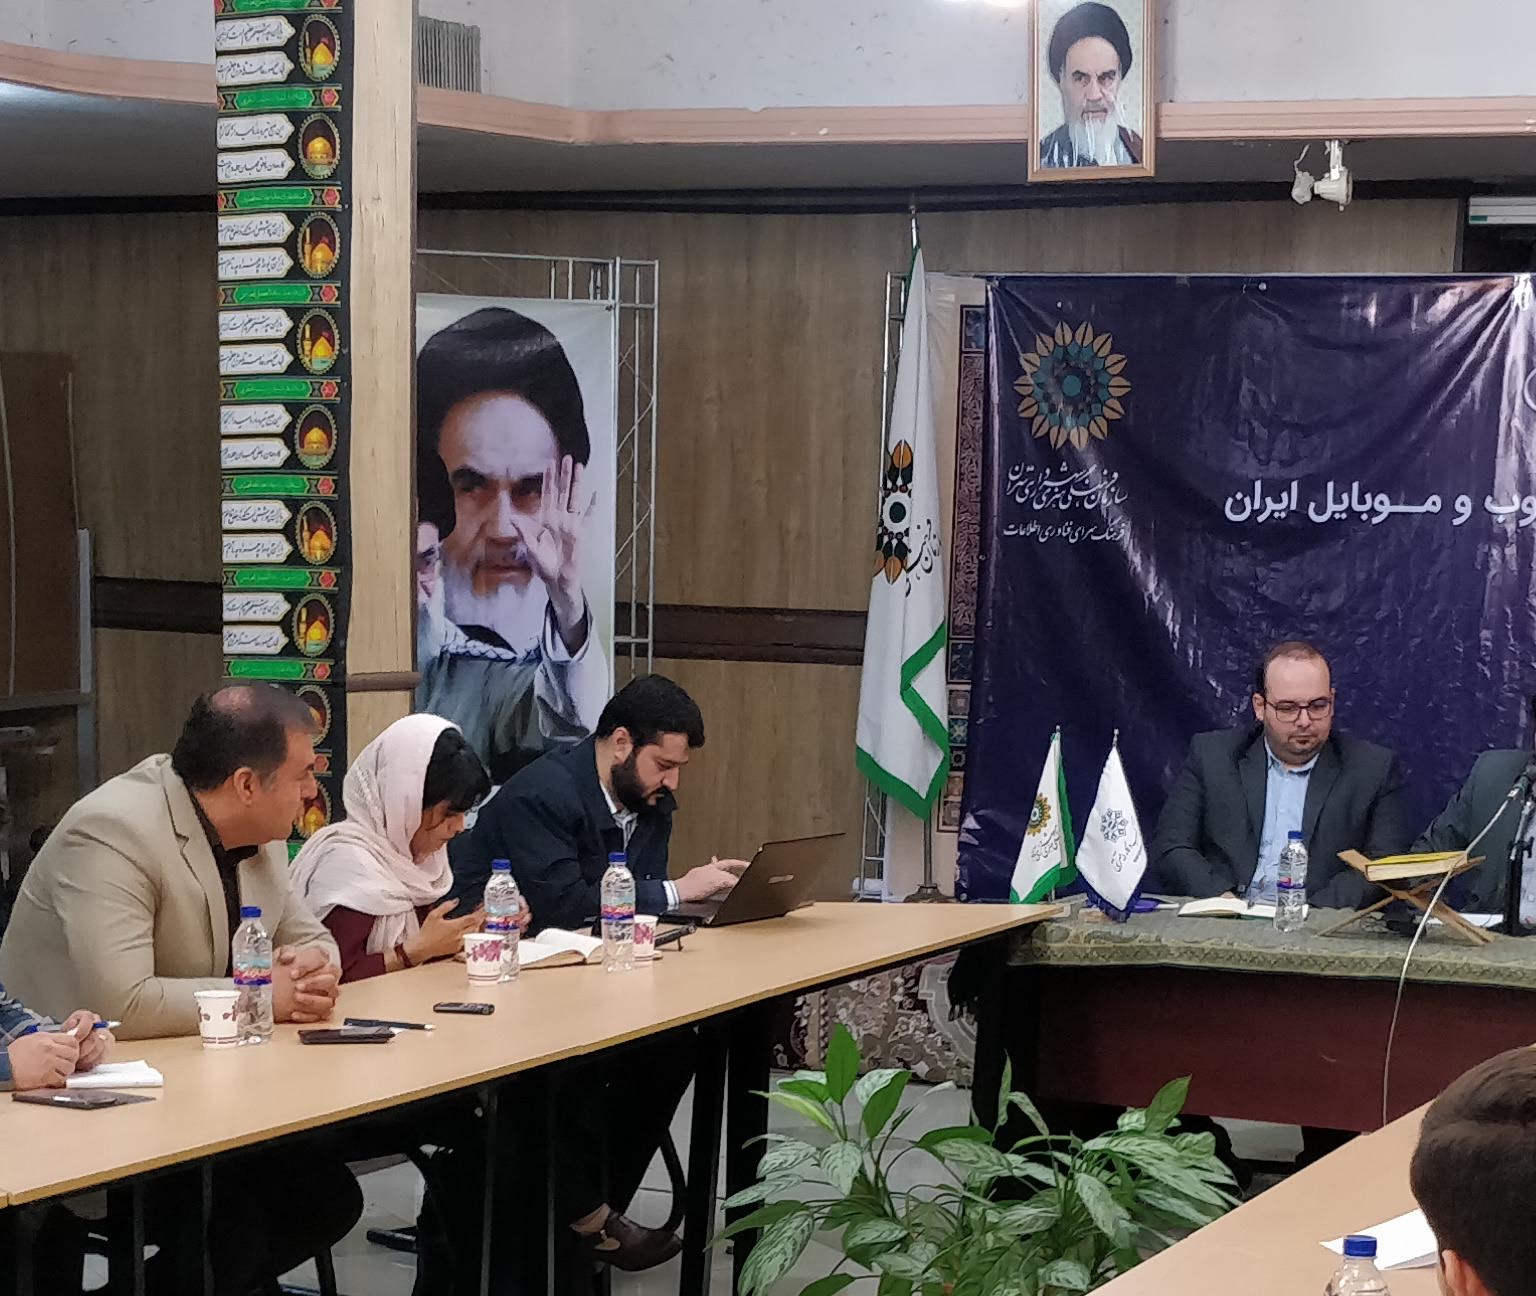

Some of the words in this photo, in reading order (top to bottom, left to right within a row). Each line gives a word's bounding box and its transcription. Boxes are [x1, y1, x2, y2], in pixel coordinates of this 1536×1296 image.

[1224, 479, 1298, 523] ایران
[1308, 480, 1442, 525] موبایل
[1452, 494, 1472, 526] و
